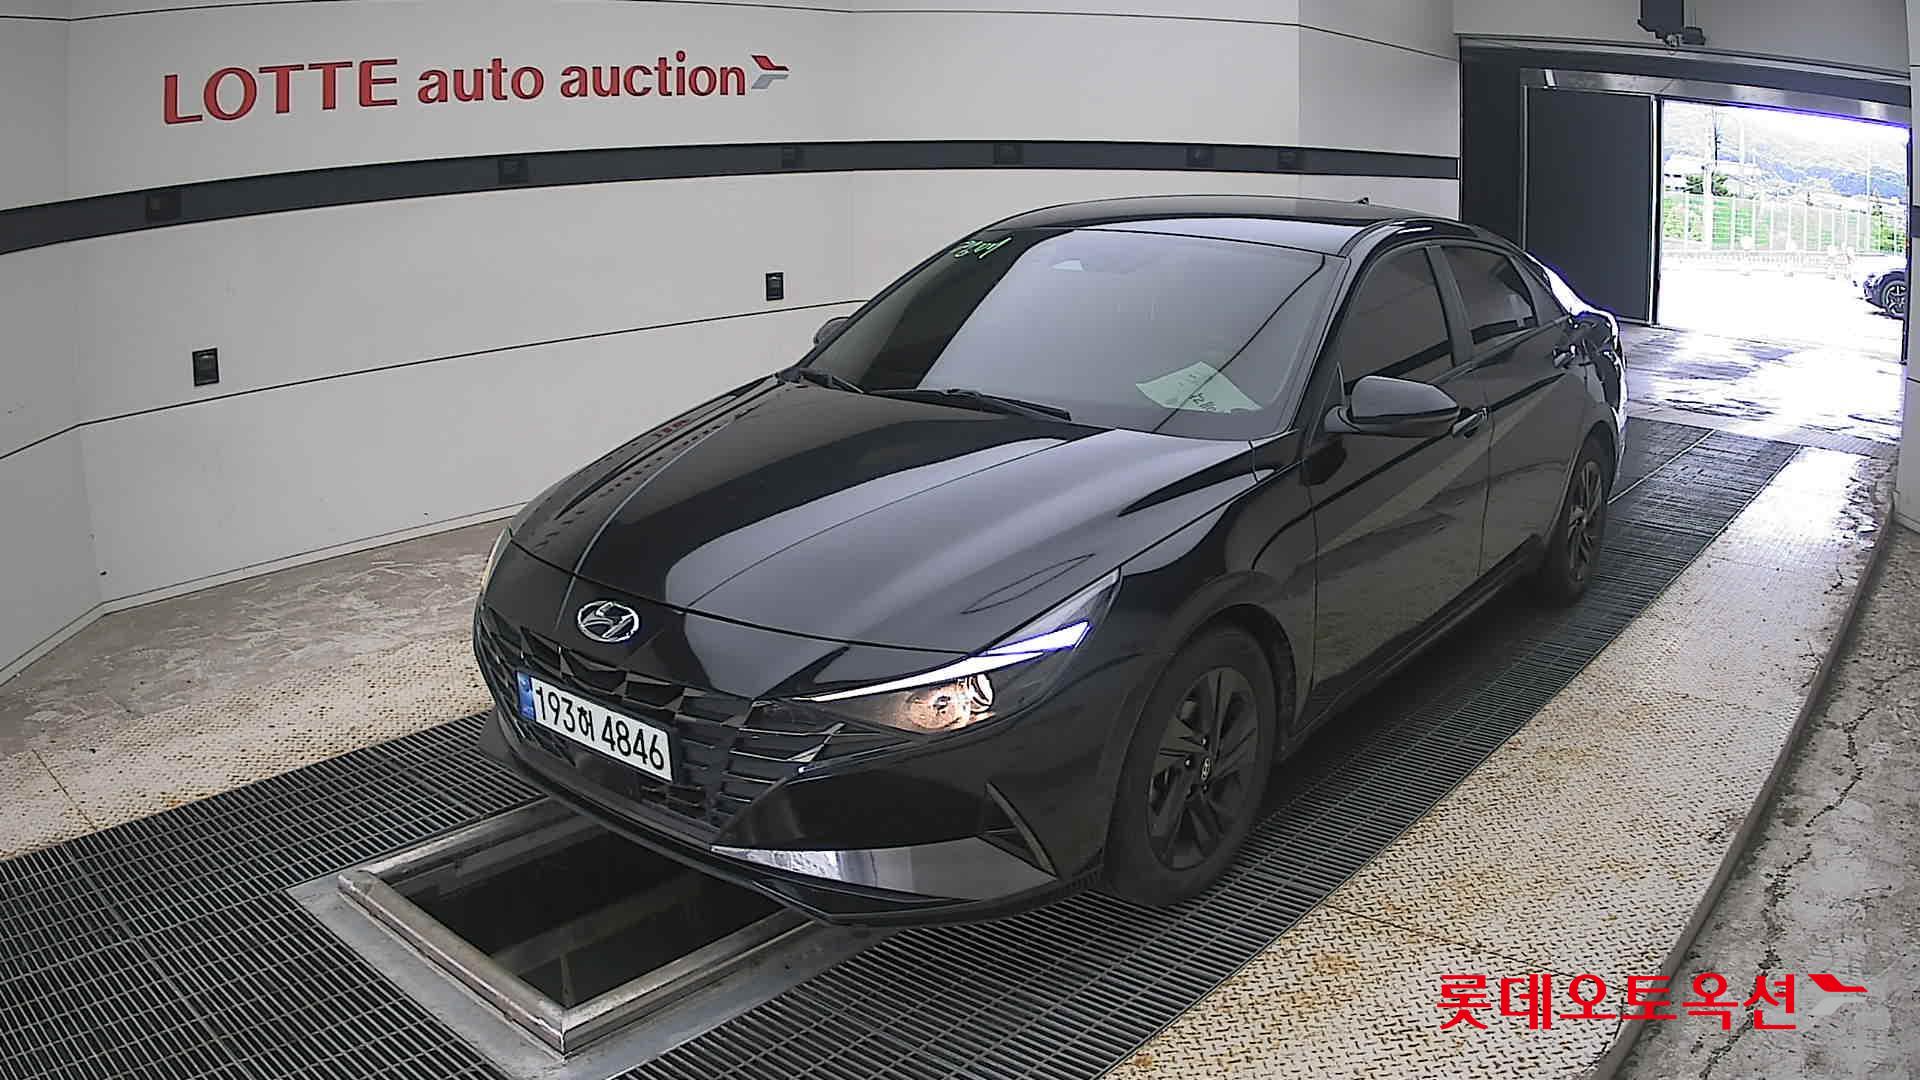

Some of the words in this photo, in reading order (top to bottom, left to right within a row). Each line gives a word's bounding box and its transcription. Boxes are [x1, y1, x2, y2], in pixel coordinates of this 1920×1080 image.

[164, 59, 398, 124] LOTTE
[418, 58, 543, 102] auto
[561, 52, 746, 98] auction
[601, 715, 665, 770] 4846
